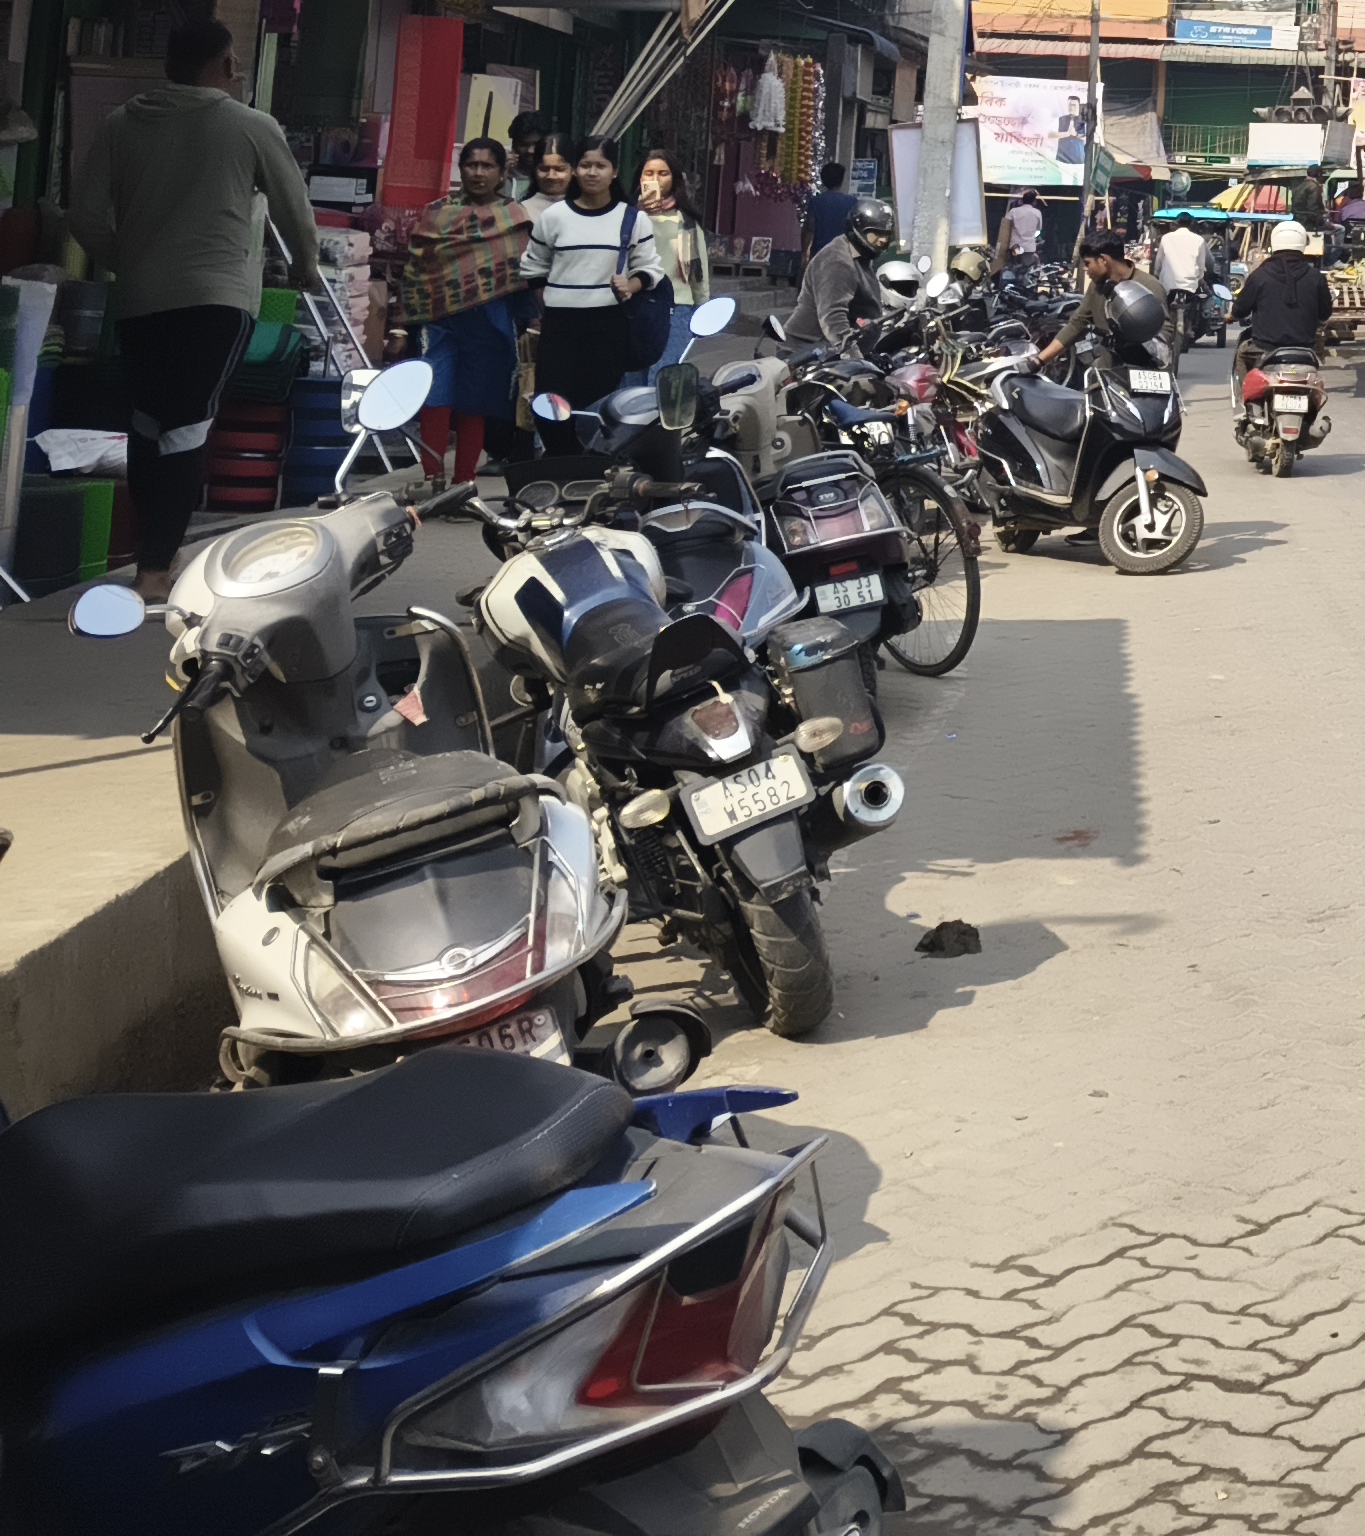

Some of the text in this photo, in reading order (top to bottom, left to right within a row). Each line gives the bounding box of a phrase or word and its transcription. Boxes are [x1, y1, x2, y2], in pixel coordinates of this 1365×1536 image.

[834, 587, 874, 608] 30 51
[737, 1488, 791, 1529] HONDA
